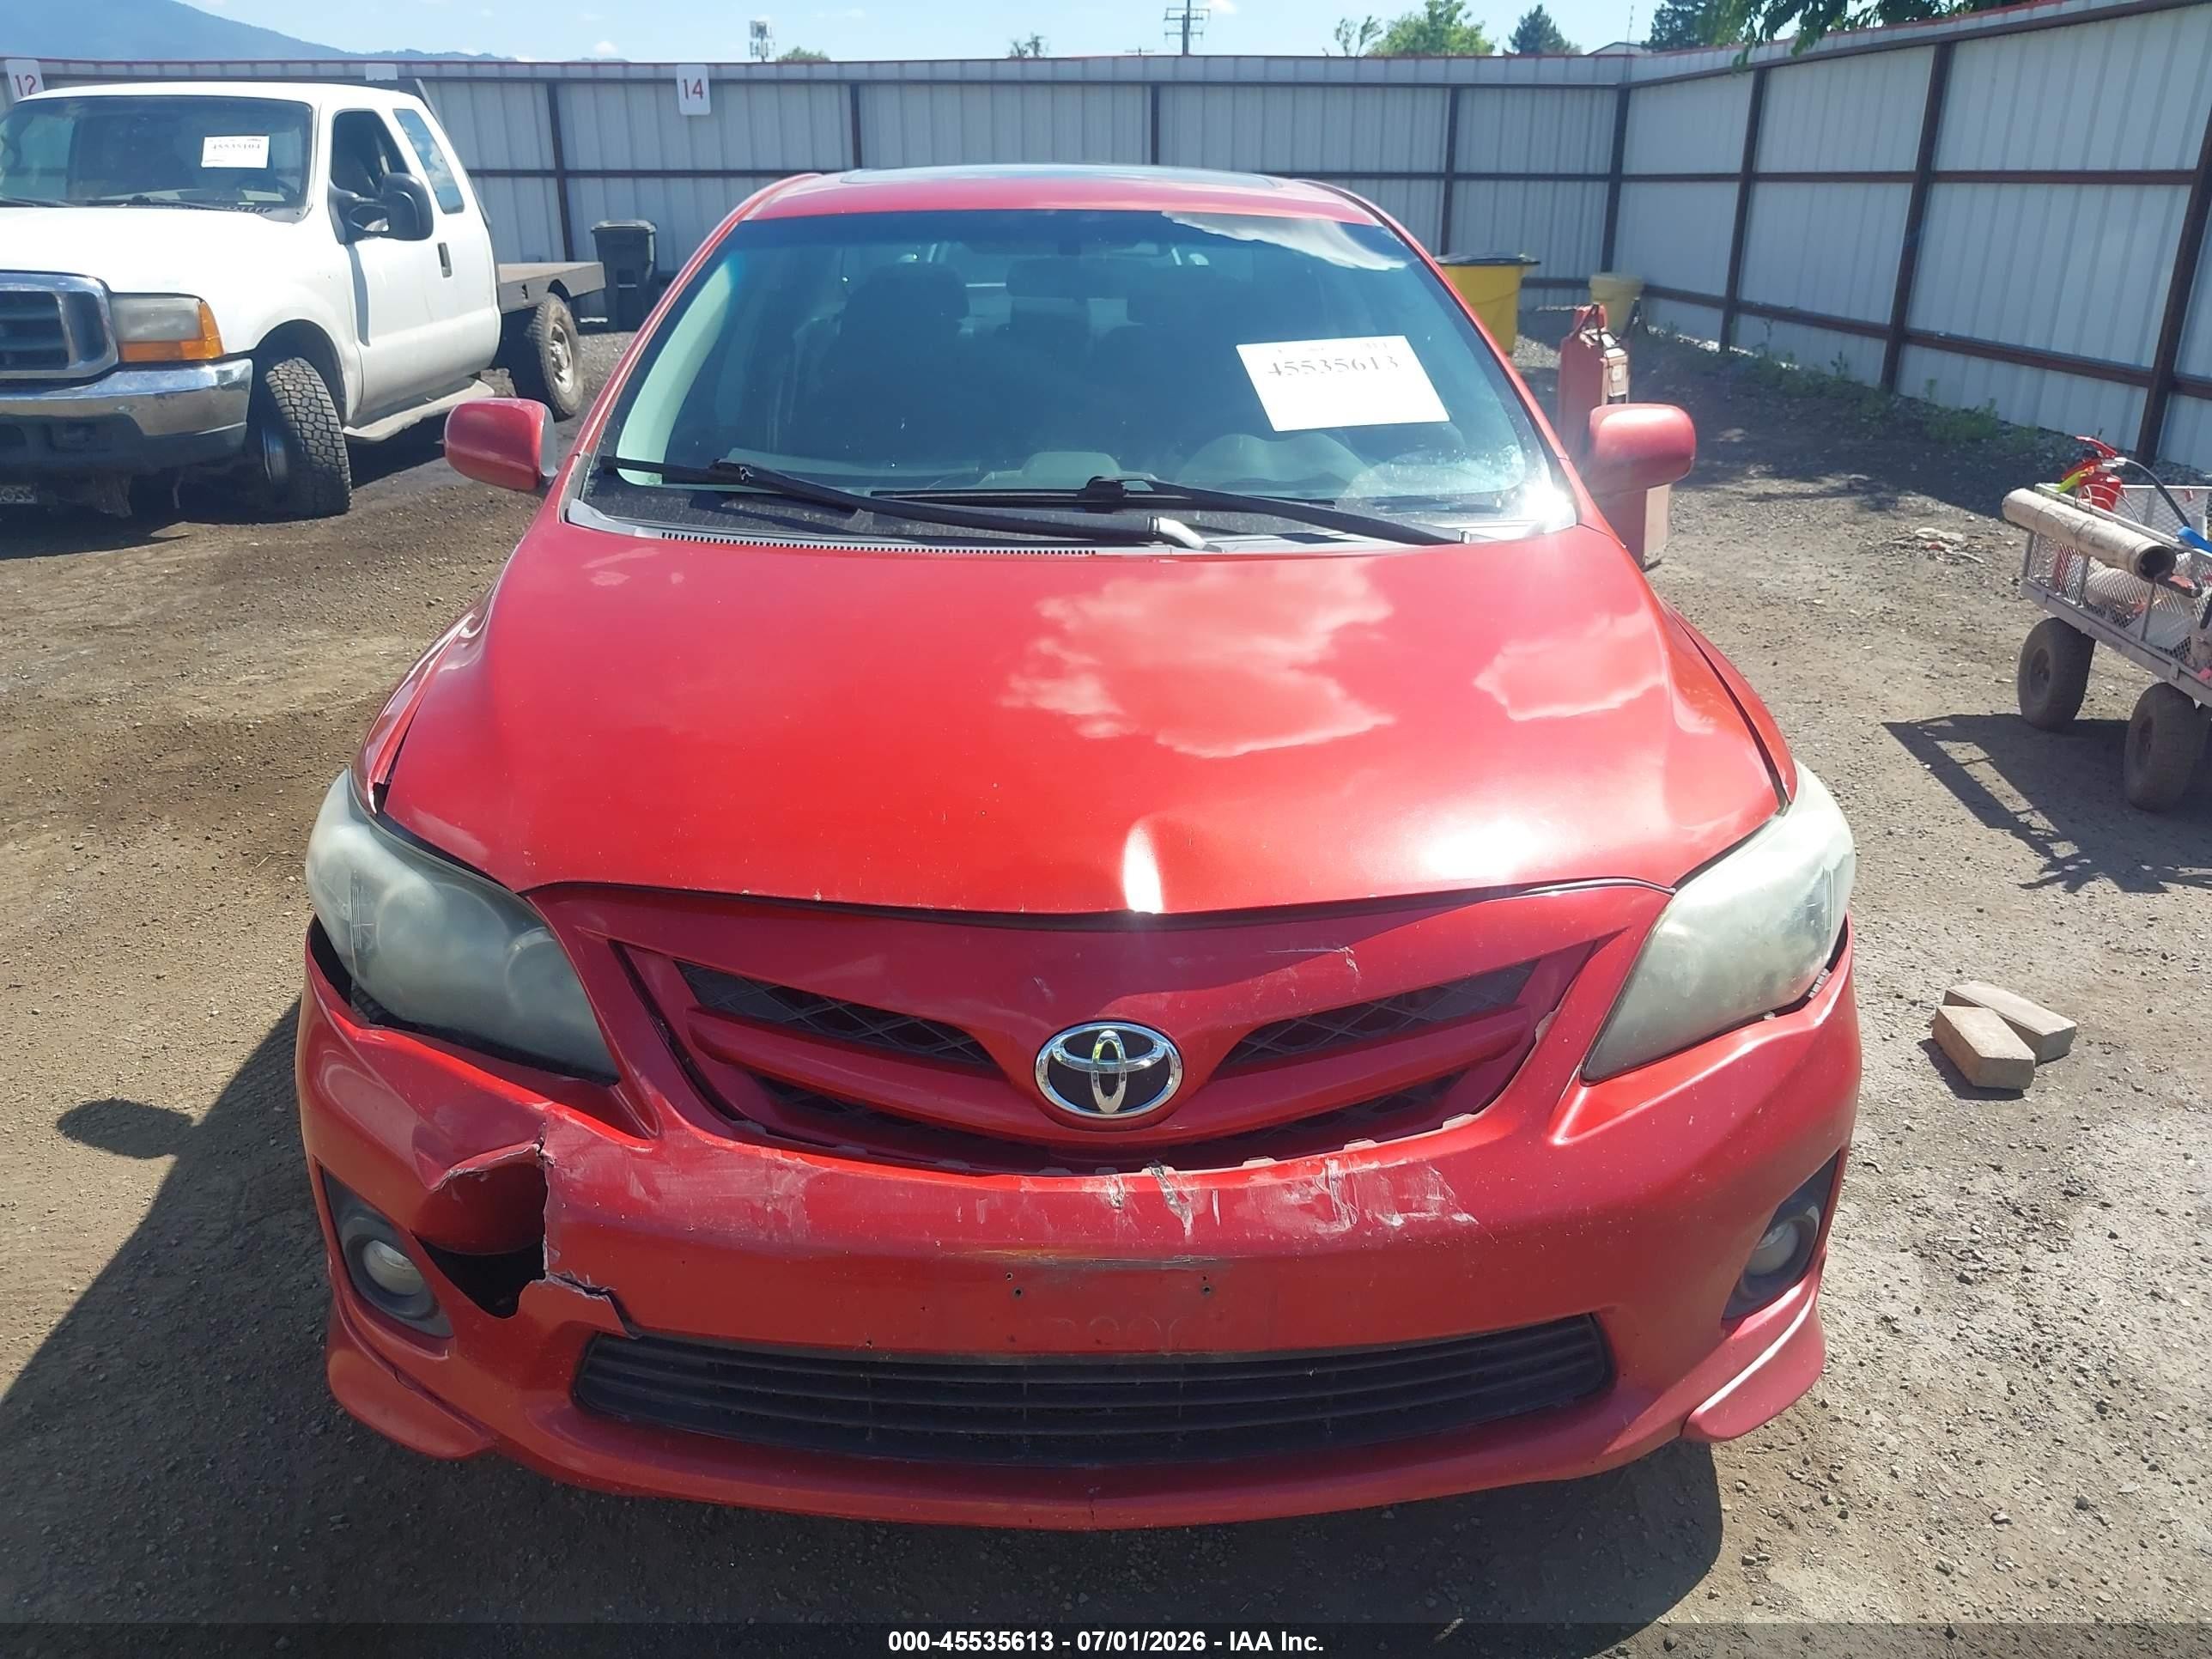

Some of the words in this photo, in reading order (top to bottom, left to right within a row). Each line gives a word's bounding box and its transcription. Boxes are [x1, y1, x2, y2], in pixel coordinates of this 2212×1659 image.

[15, 74, 36, 96] 12
[684, 78, 704, 100] 14
[1267, 356, 1399, 375] 45535613
